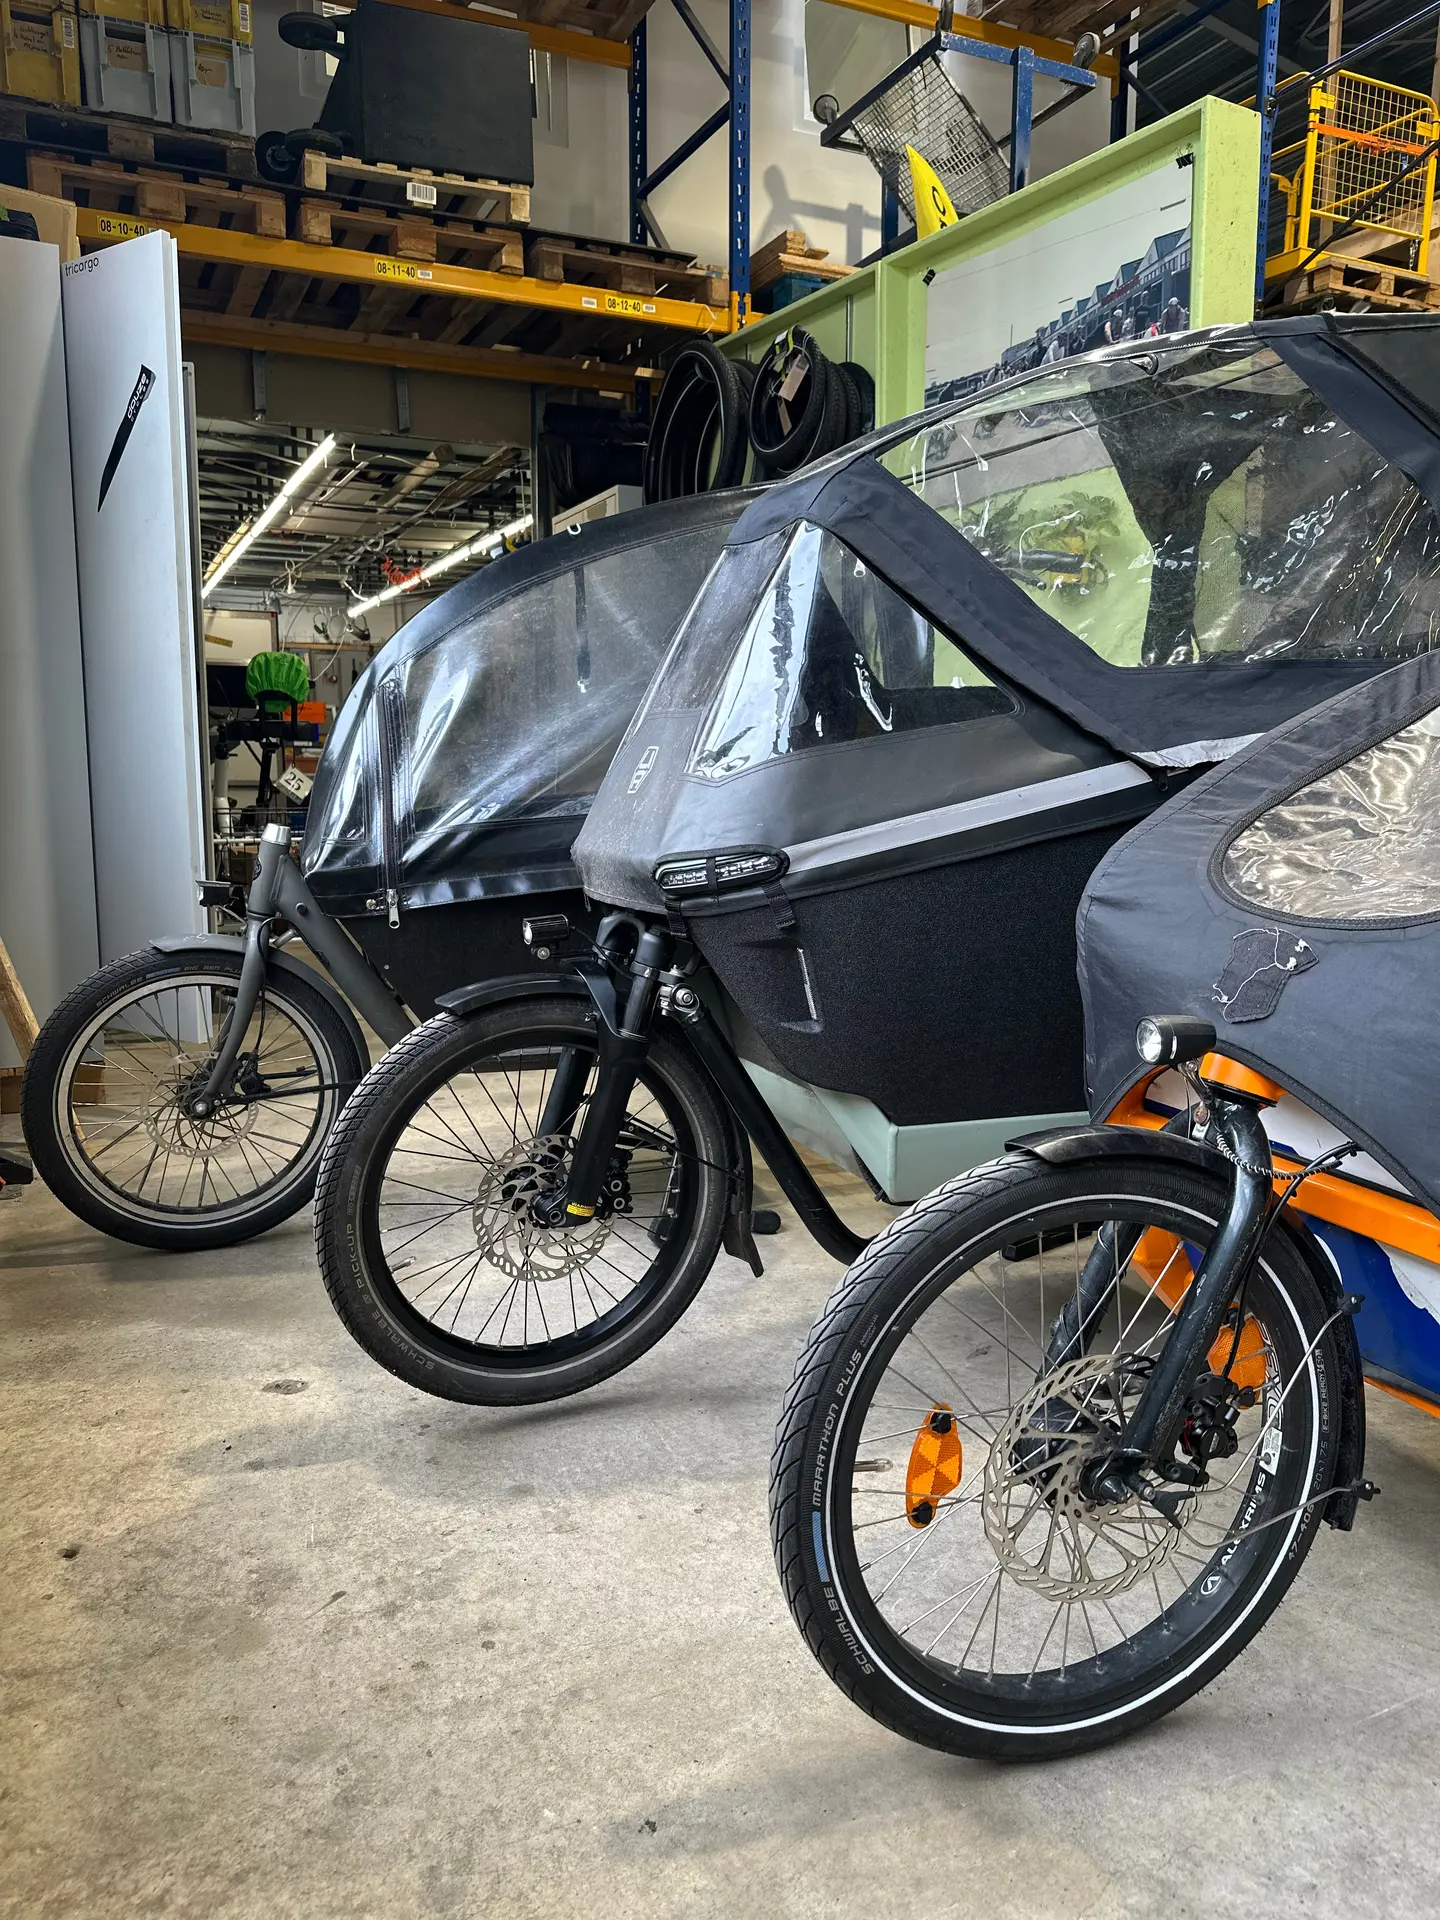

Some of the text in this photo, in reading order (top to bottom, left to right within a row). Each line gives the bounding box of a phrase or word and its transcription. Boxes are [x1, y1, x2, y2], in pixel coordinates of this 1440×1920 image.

[100, 219, 145, 237] 08-10-40
[64, 257, 99, 277] tricargo
[377, 262, 416, 278] 08-11-40
[607, 297, 642, 313] 08-12-40
[127, 372, 147, 419] douze
[283, 771, 305, 792] 25
[96, 976, 144, 1008] SCHWALBE
[346, 1223, 437, 1371] SCHWALBE PICK-UP
[812, 1348, 876, 1676] SCHWALBE MARATHON PLUS
[1287, 1501, 1315, 1561] 47-406
